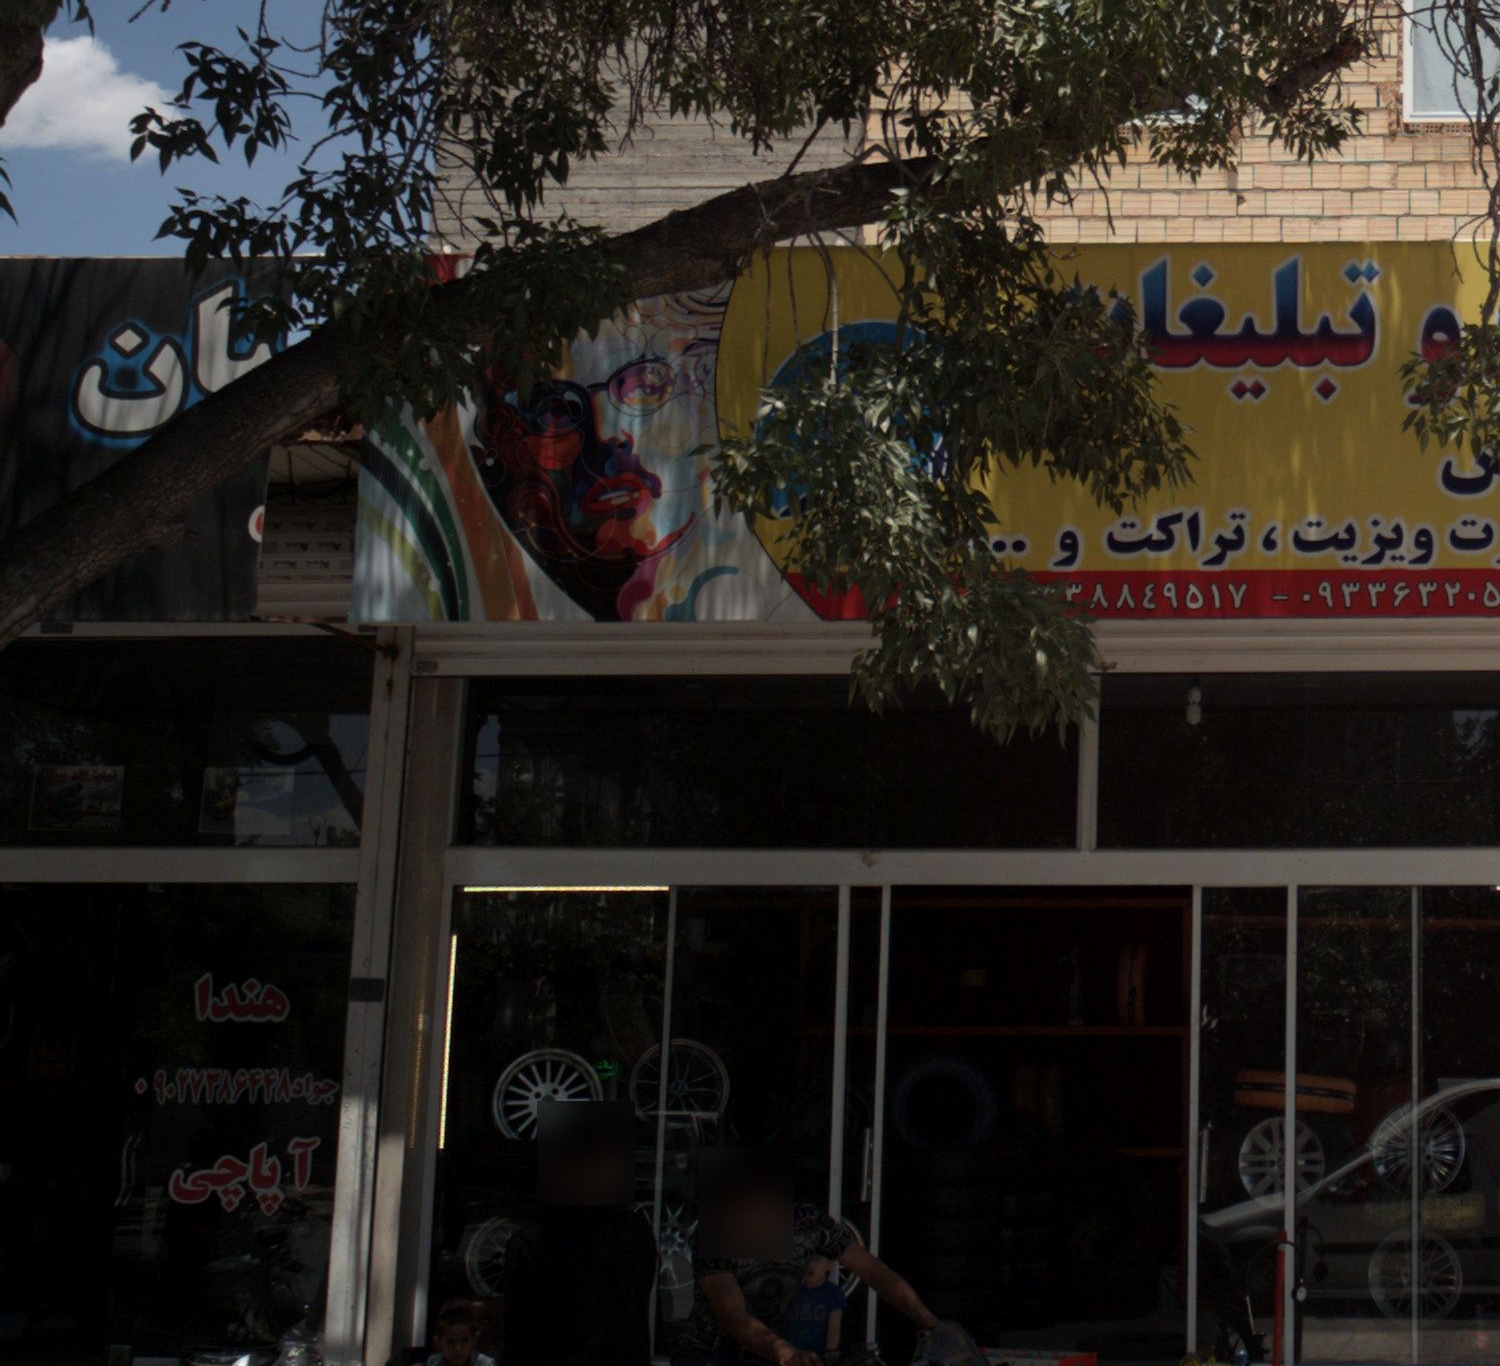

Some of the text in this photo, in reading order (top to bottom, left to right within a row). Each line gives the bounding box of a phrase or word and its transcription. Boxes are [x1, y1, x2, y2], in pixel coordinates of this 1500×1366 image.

[1062, 257, 1379, 402] تبلیغا
[1051, 530, 1080, 567] و
[1107, 512, 1247, 567] تراکت
[194, 971, 290, 1022] هندا
